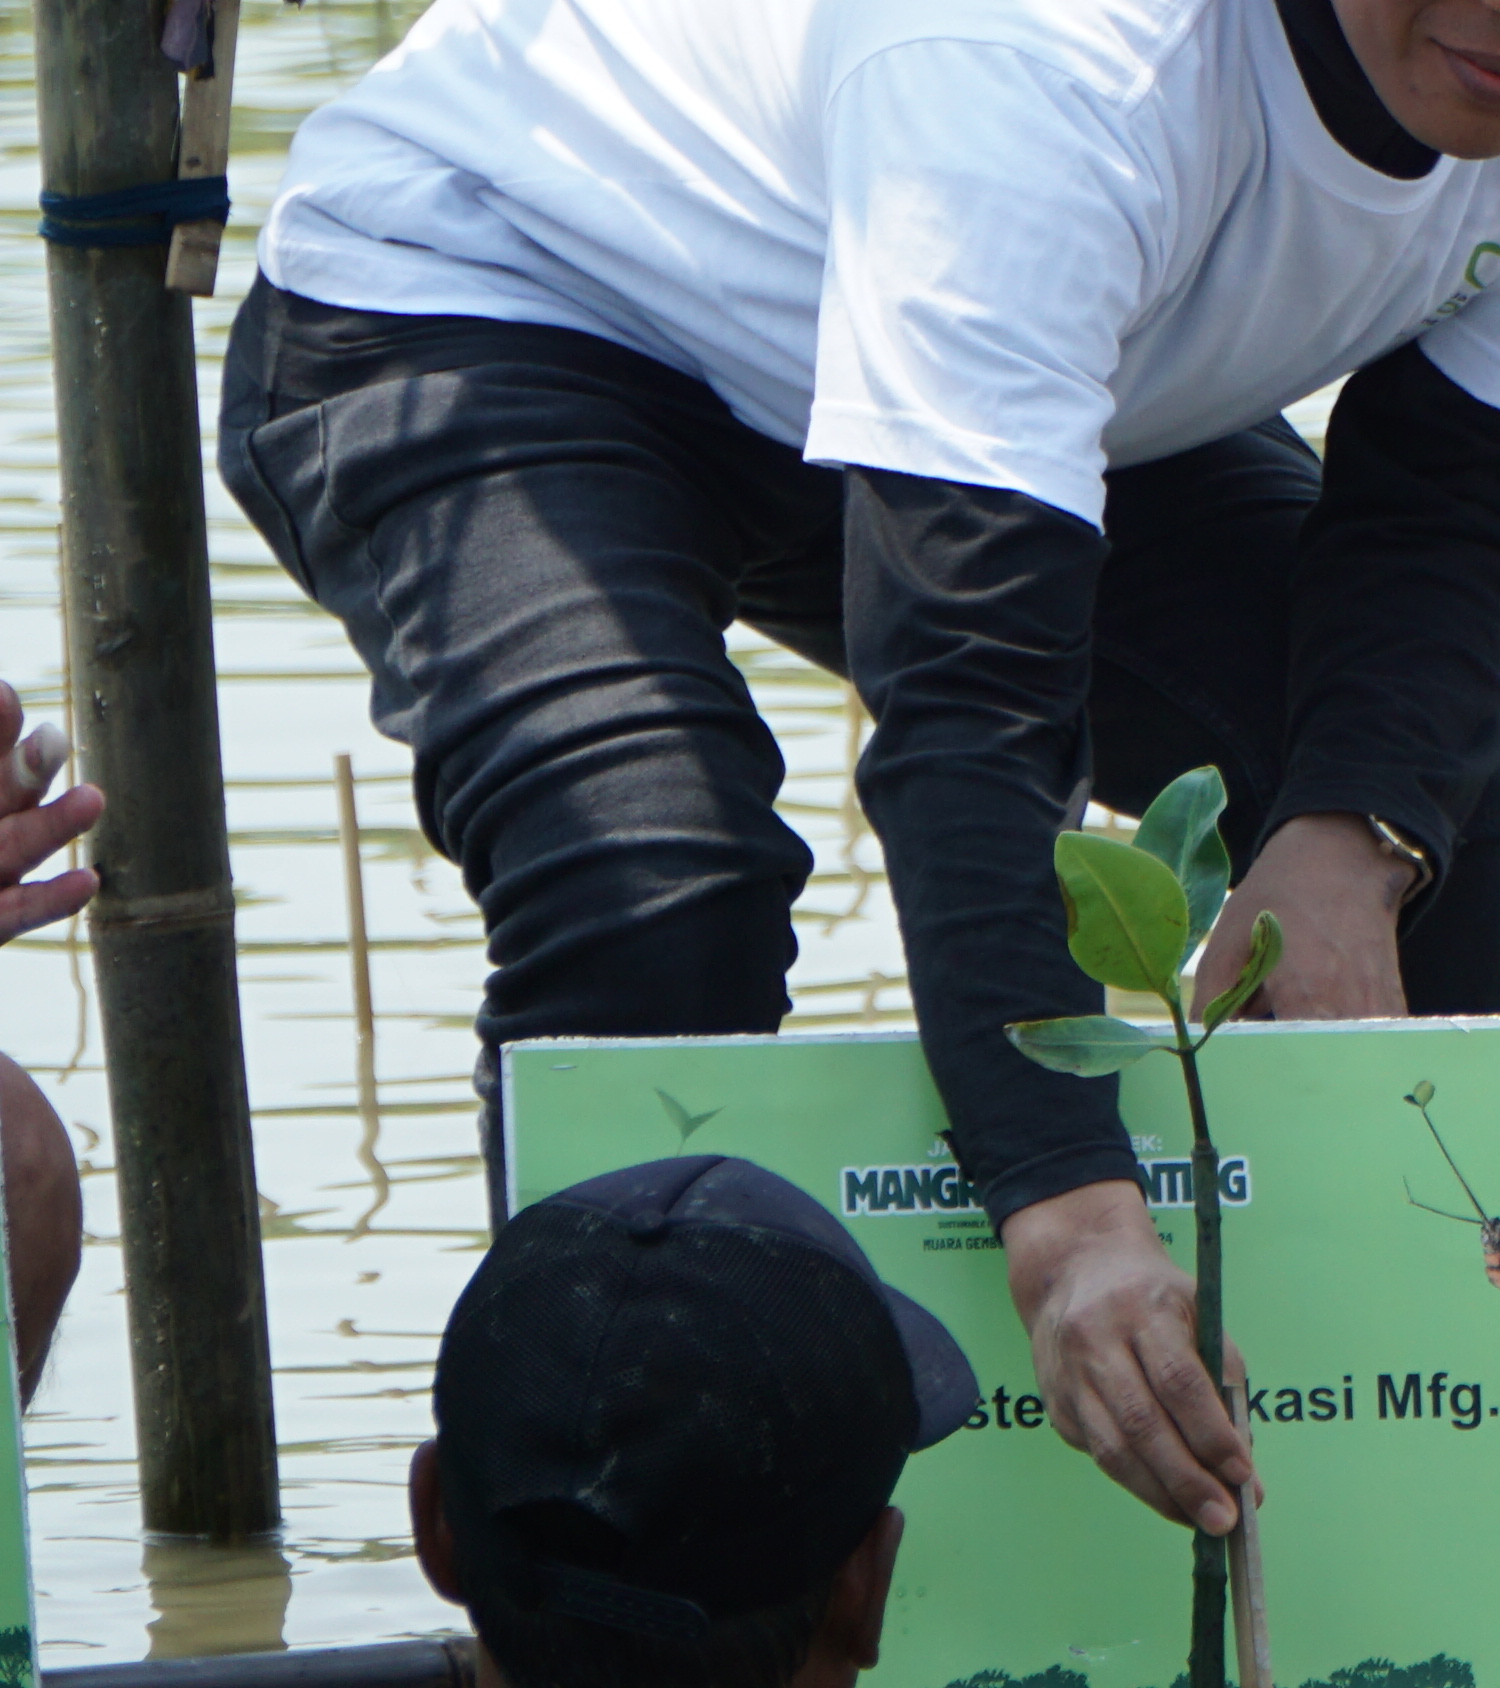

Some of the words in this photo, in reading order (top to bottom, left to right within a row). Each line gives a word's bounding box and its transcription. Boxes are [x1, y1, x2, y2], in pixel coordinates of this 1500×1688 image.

[965, 1235, 1003, 1250] GEMB
[1246, 1374, 1354, 1424] kasi
[1377, 1371, 1500, 1431] Mfg.
